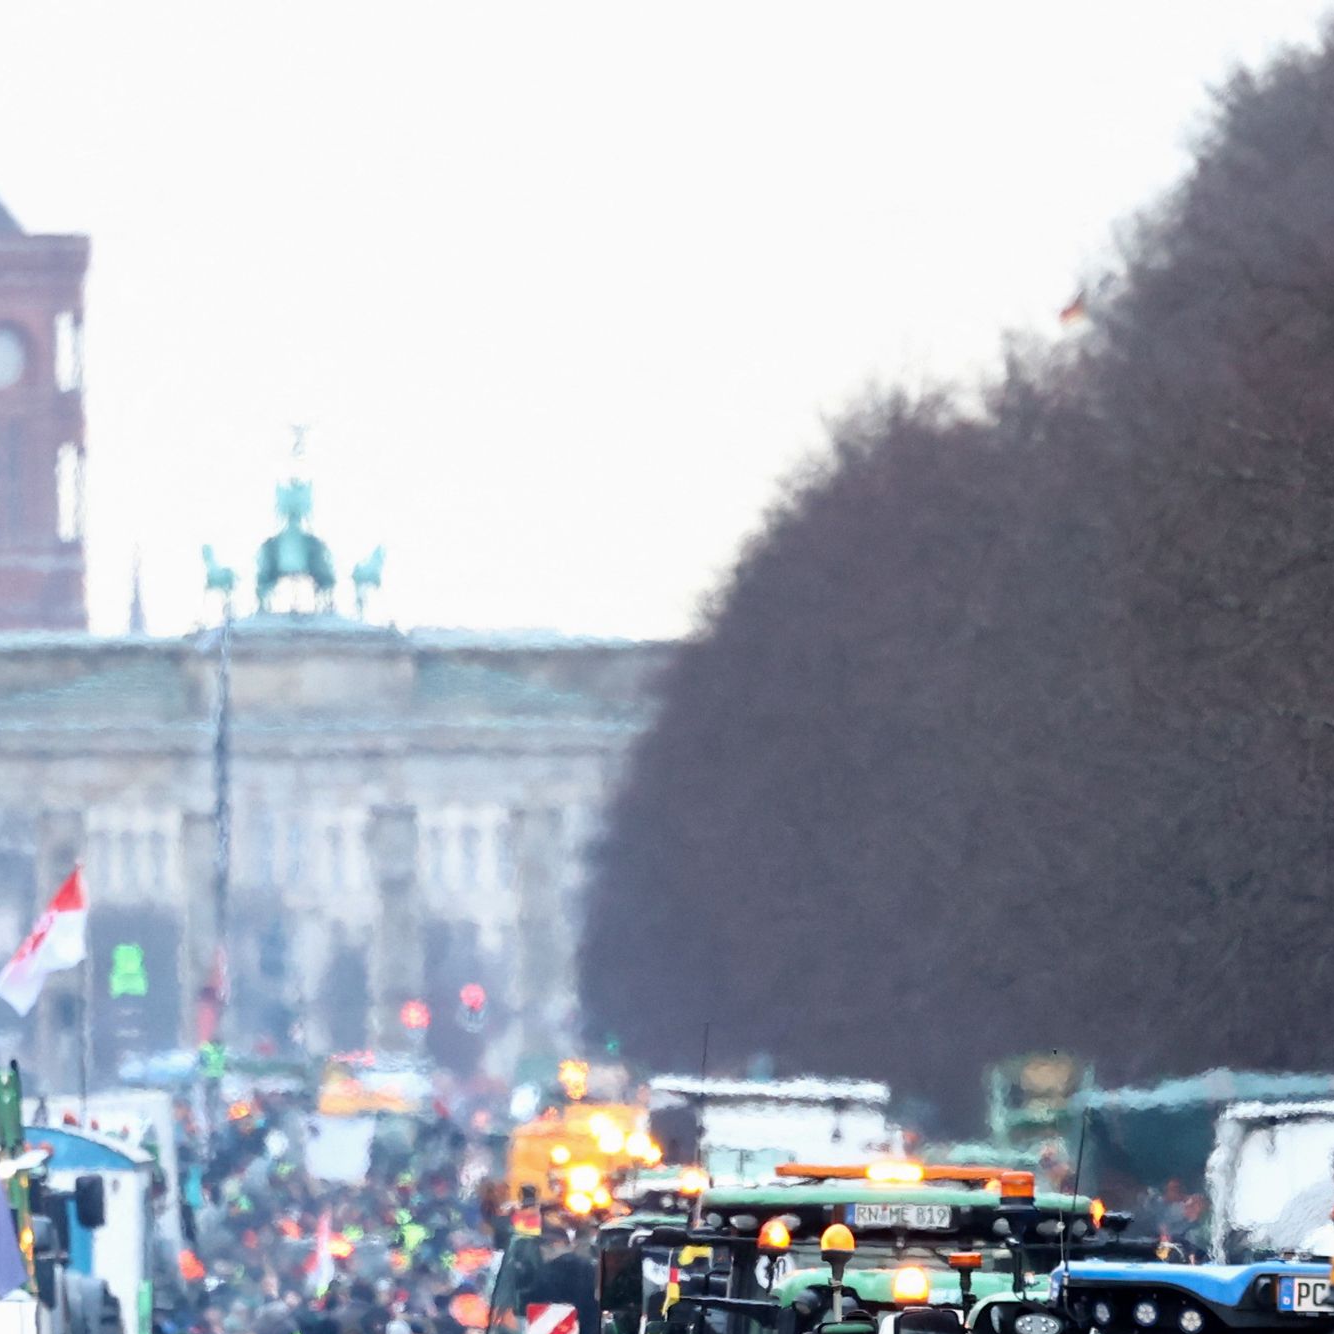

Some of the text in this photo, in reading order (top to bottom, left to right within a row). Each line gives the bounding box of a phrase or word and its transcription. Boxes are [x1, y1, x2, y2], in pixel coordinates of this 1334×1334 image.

[857, 1206, 948, 1225] RN ME 819
